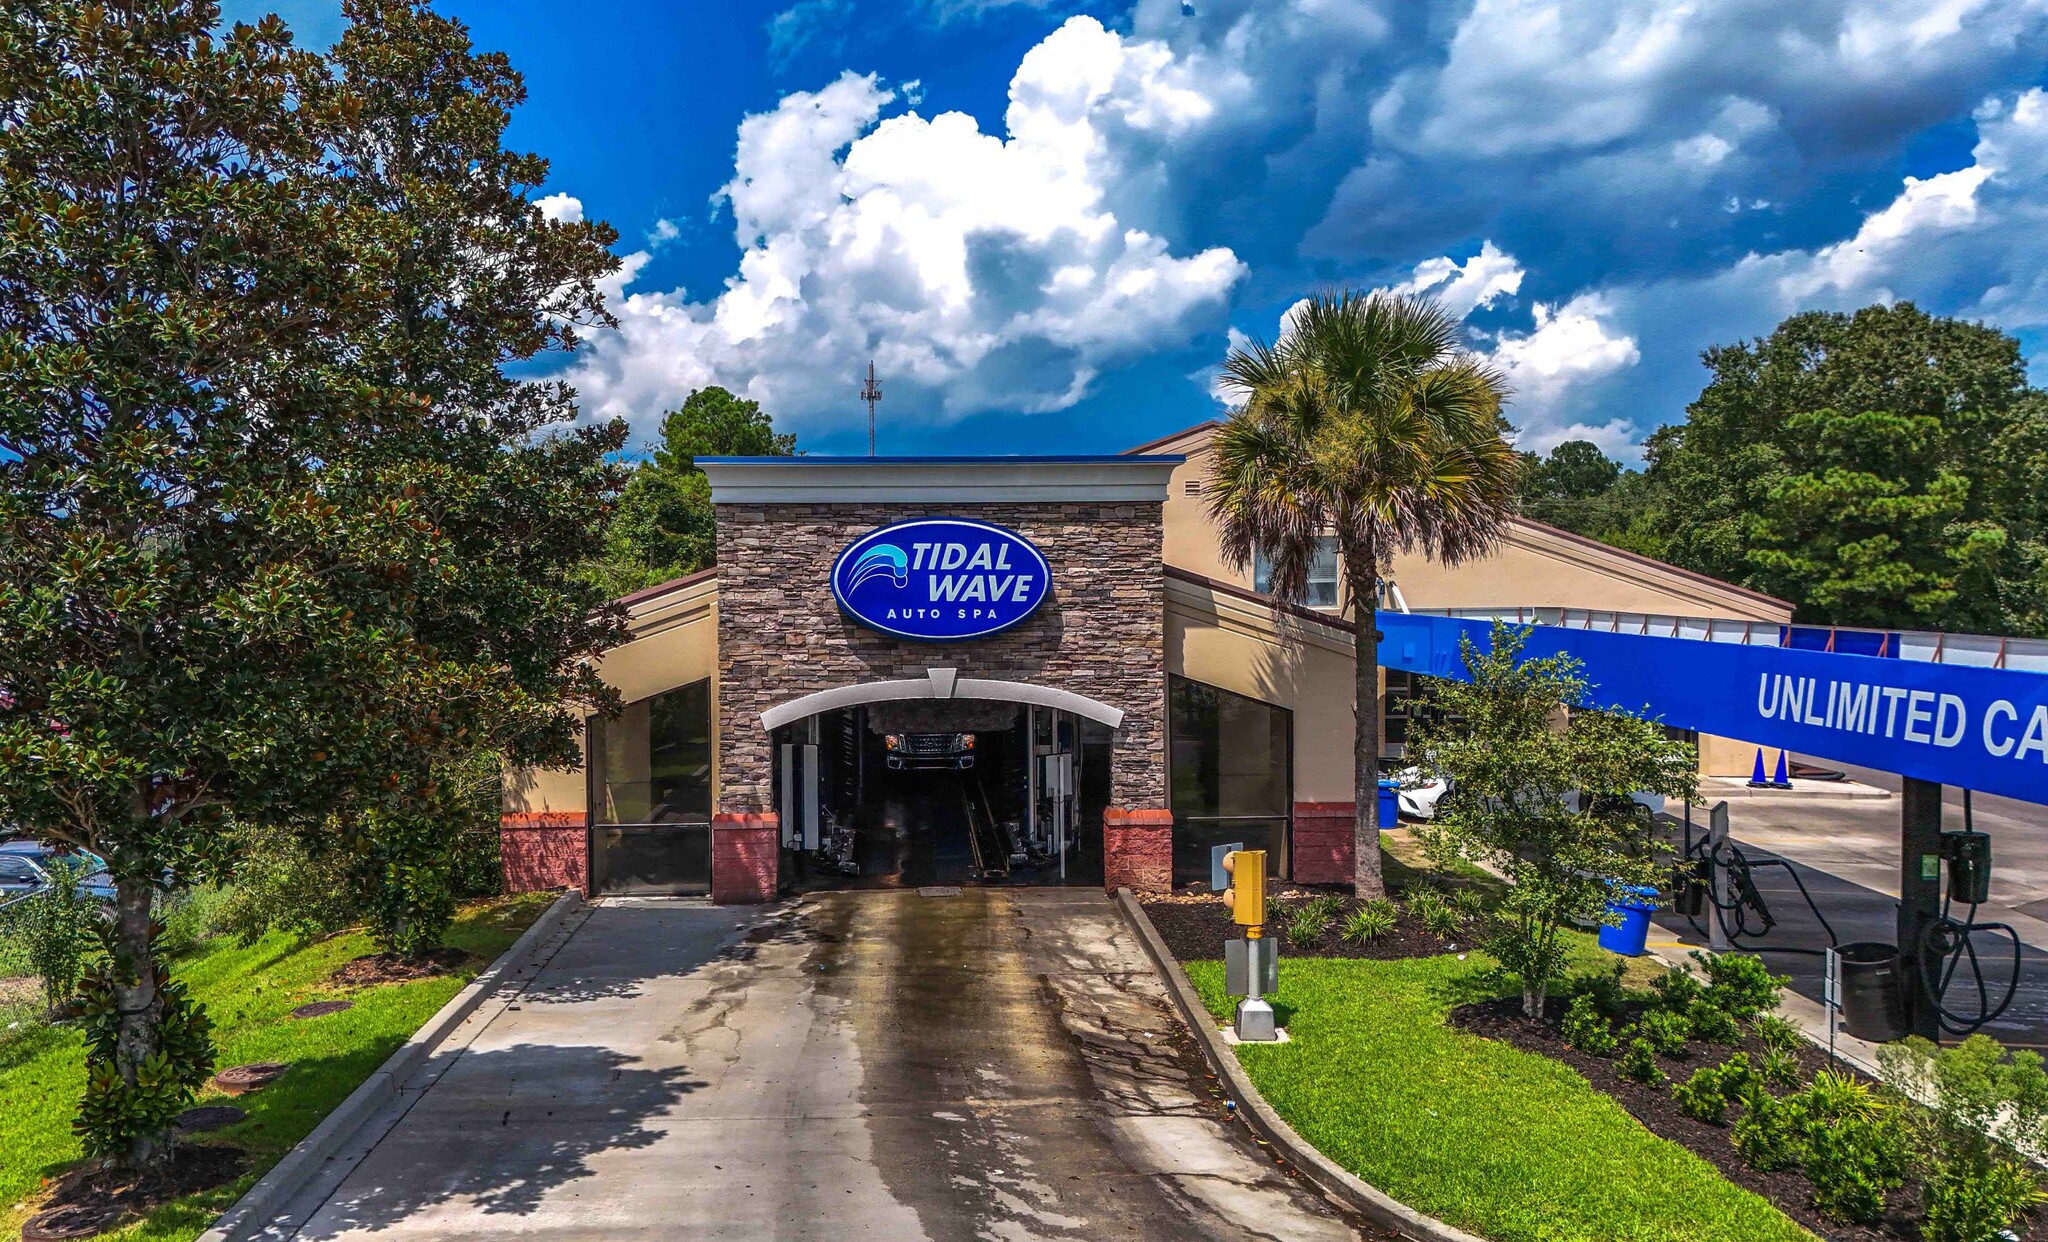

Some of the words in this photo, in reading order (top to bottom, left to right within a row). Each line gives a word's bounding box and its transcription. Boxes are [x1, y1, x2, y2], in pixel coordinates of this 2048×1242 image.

[912, 543, 1012, 570] TIDAL
[928, 574, 1033, 602] WAVE
[887, 608, 941, 619] AUTO
[958, 608, 997, 619] SPA
[1758, 672, 1967, 748] UNLIMITED
[1983, 699, 2048, 765] CA
